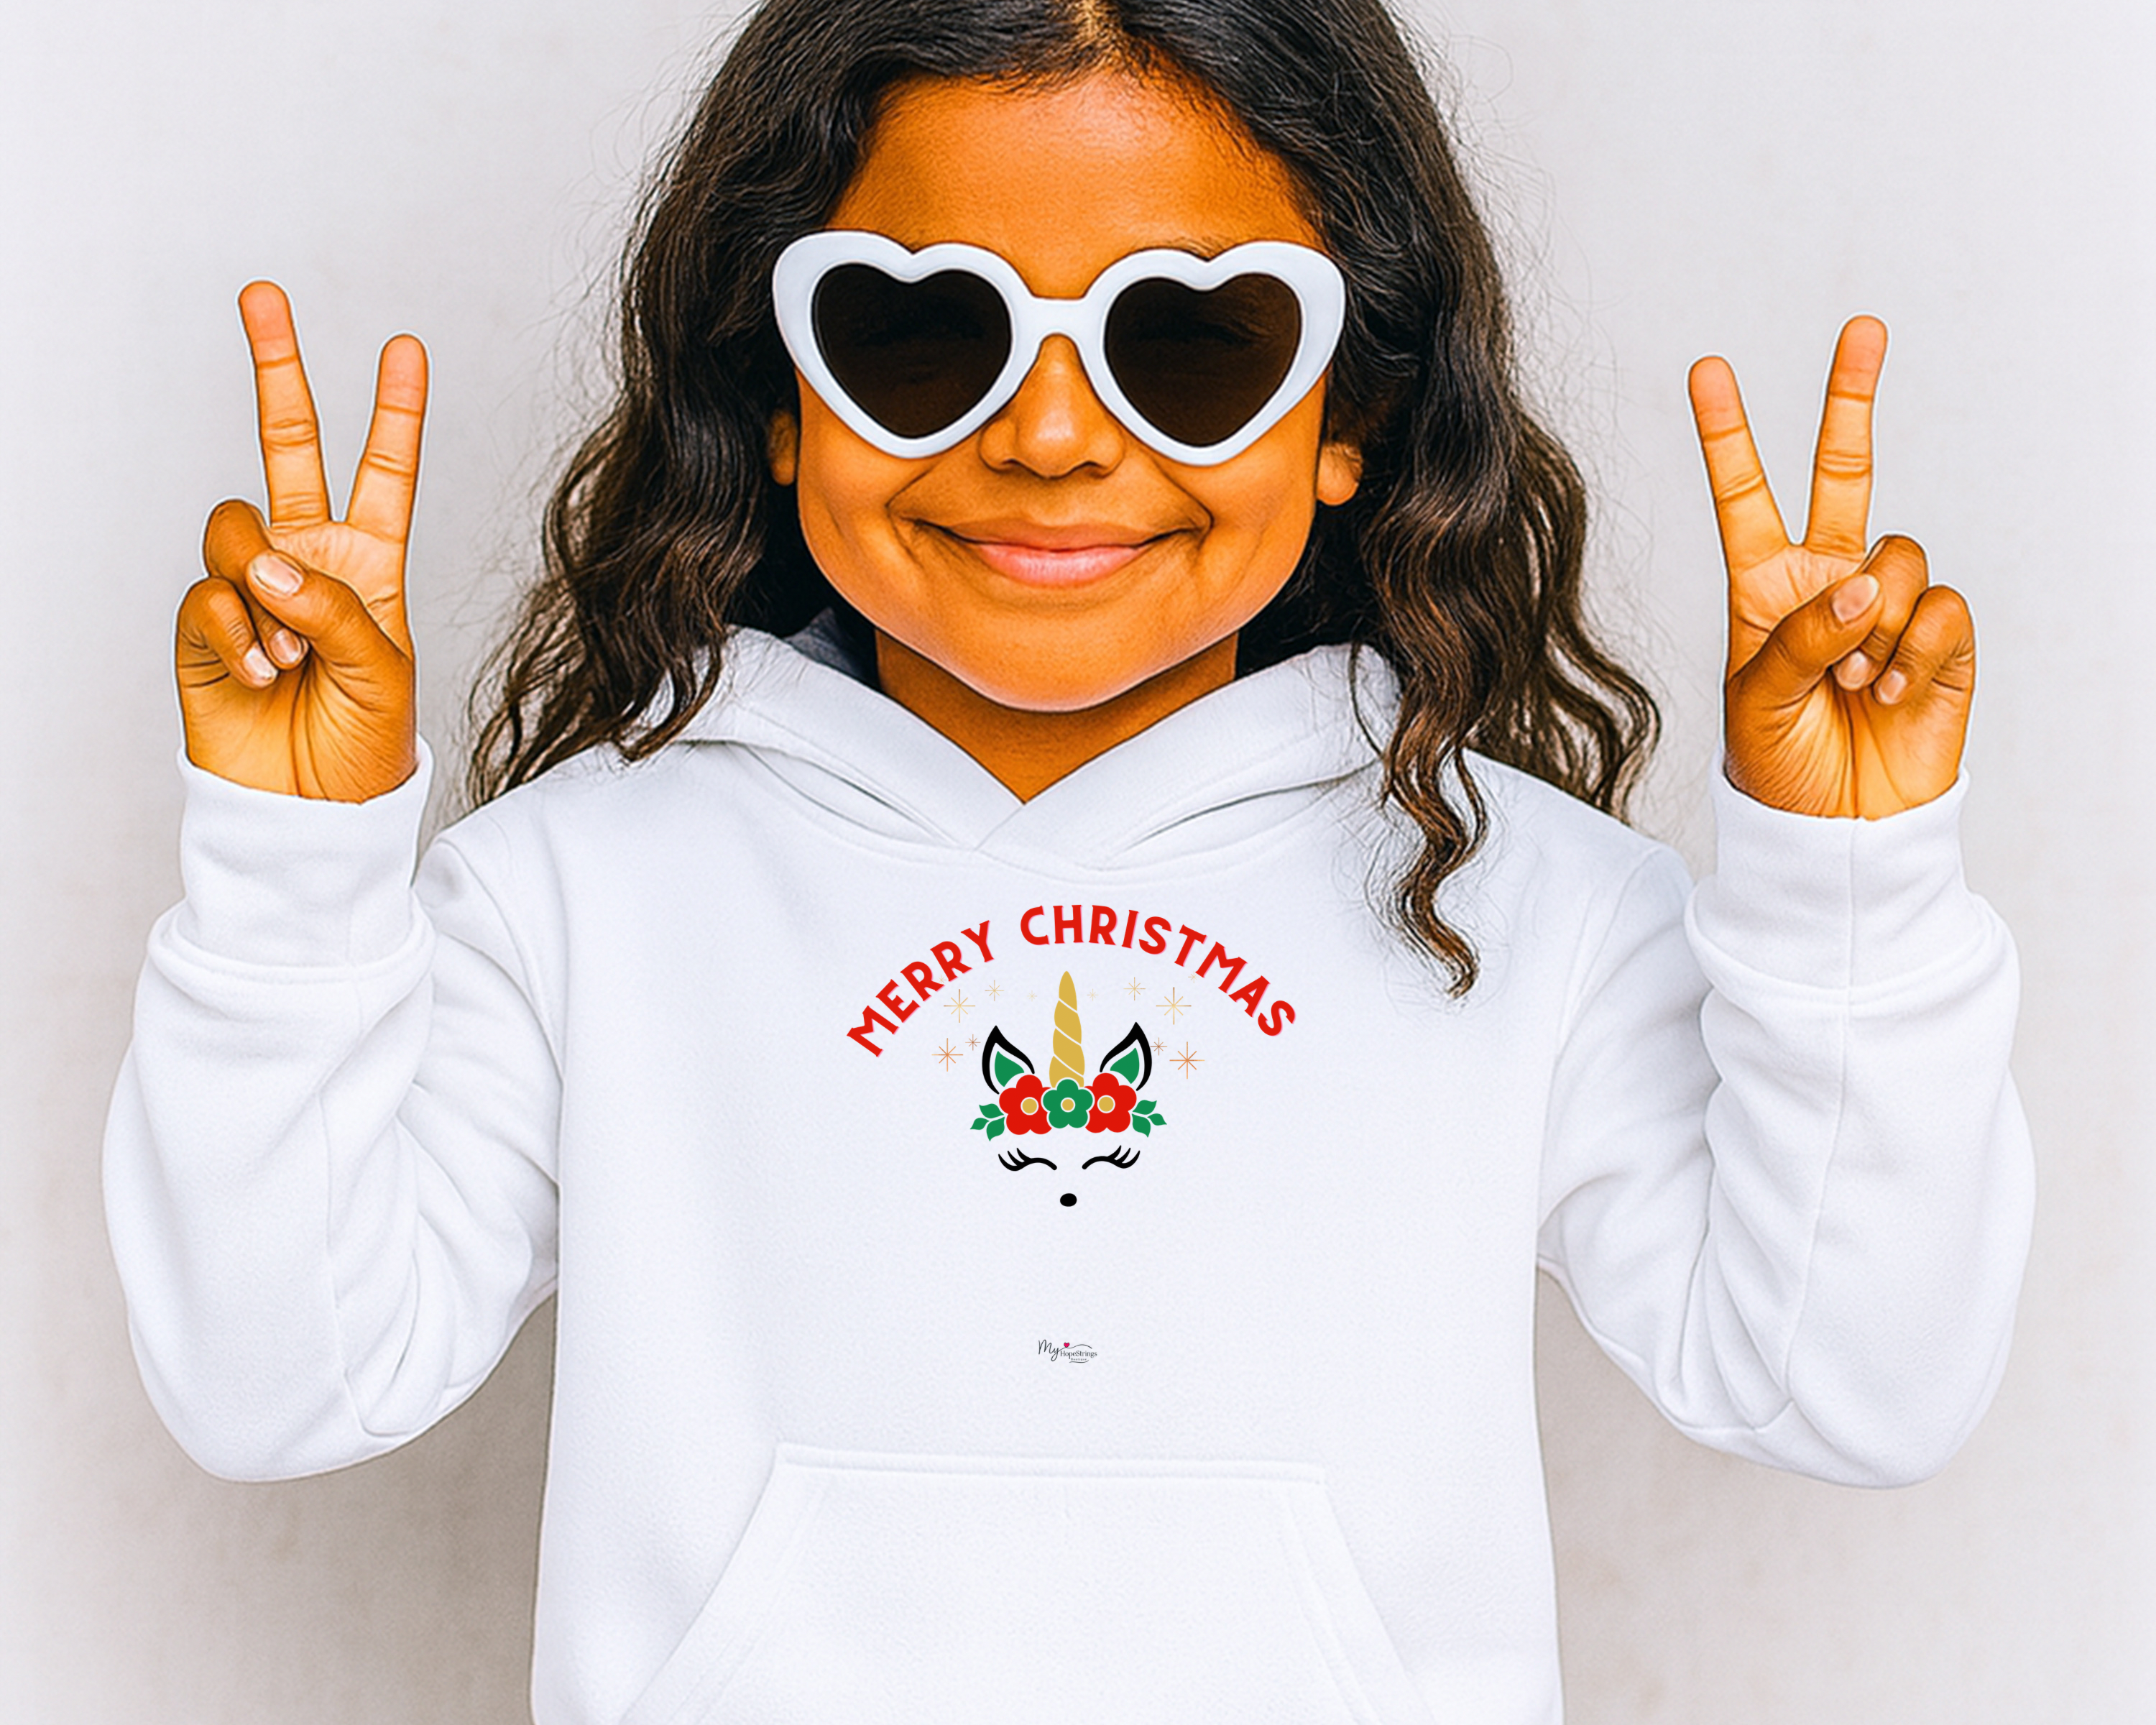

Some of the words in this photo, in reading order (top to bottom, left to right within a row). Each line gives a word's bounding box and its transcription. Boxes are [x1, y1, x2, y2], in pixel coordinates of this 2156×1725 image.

[847, 920, 995, 1057] MERRY
[1020, 904, 1296, 1036] CHRISTMAS
[1038, 1339, 1059, 1362] My
[1060, 1351, 1097, 1359] HopeStrings
